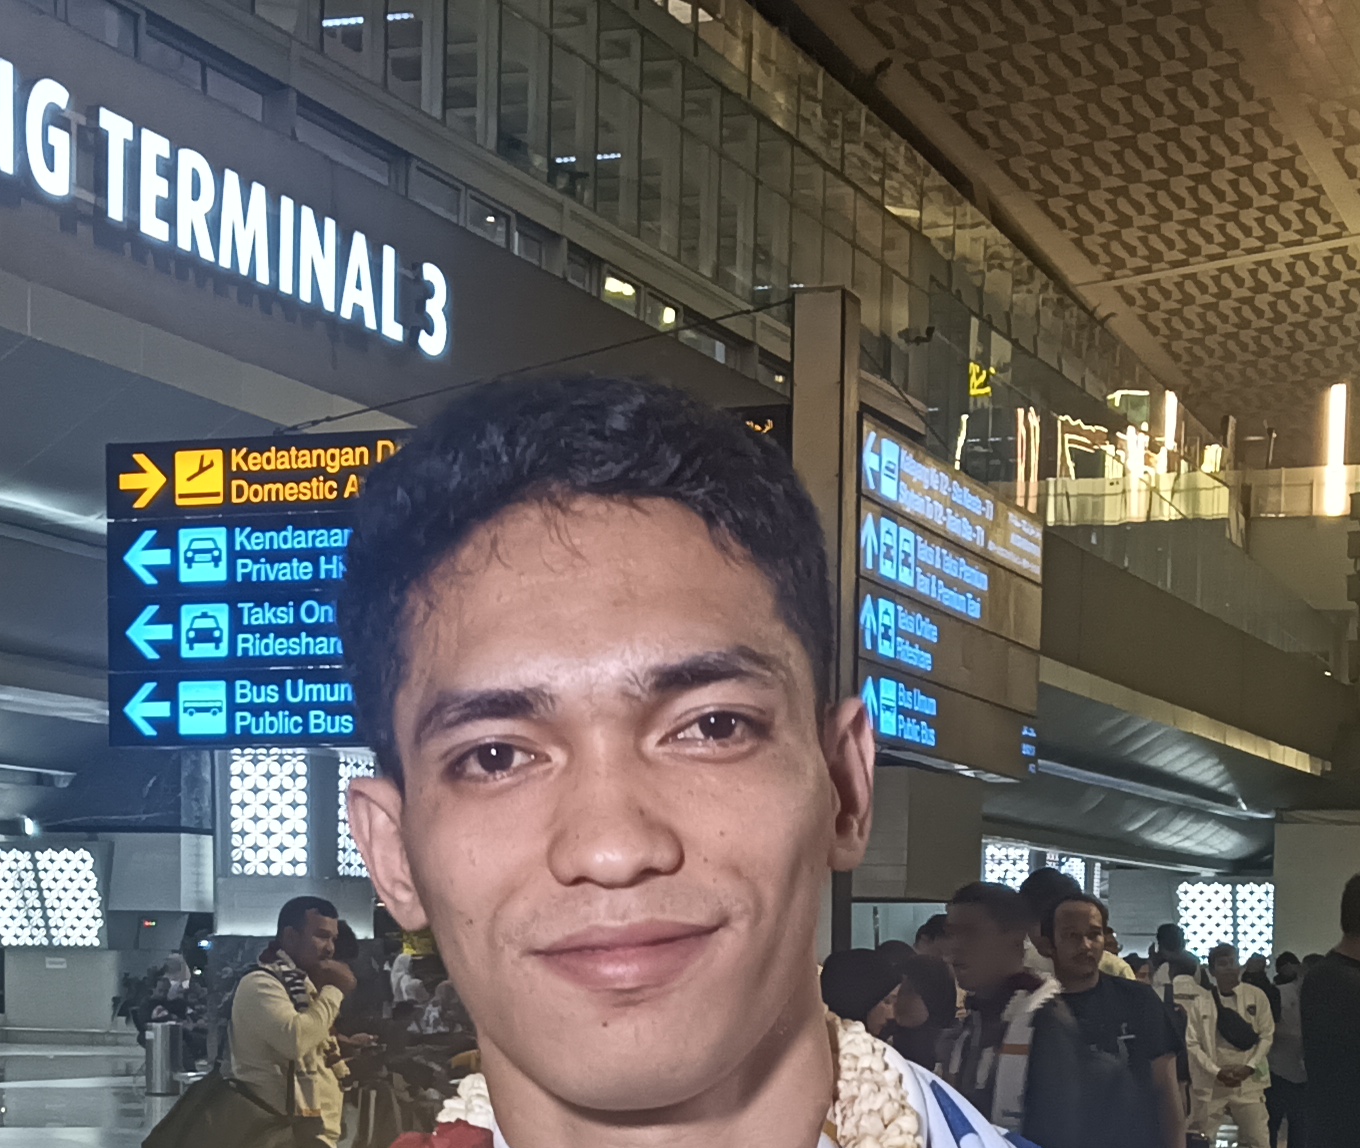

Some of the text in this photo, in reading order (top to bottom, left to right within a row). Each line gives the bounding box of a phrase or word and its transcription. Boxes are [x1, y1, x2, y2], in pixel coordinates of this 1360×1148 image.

[99, 108, 403, 342] TERMINAL
[416, 262, 449, 358] 3
[231, 446, 368, 474] Kedatangan
[231, 474, 365, 503] Domestic A
[236, 558, 313, 582] Private
[237, 601, 294, 625] Taksi
[235, 680, 279, 703] Bus
[898, 683, 937, 716] Bus Umum
[235, 710, 353, 734] Public Bus
[898, 714, 936, 747] Public Bus
